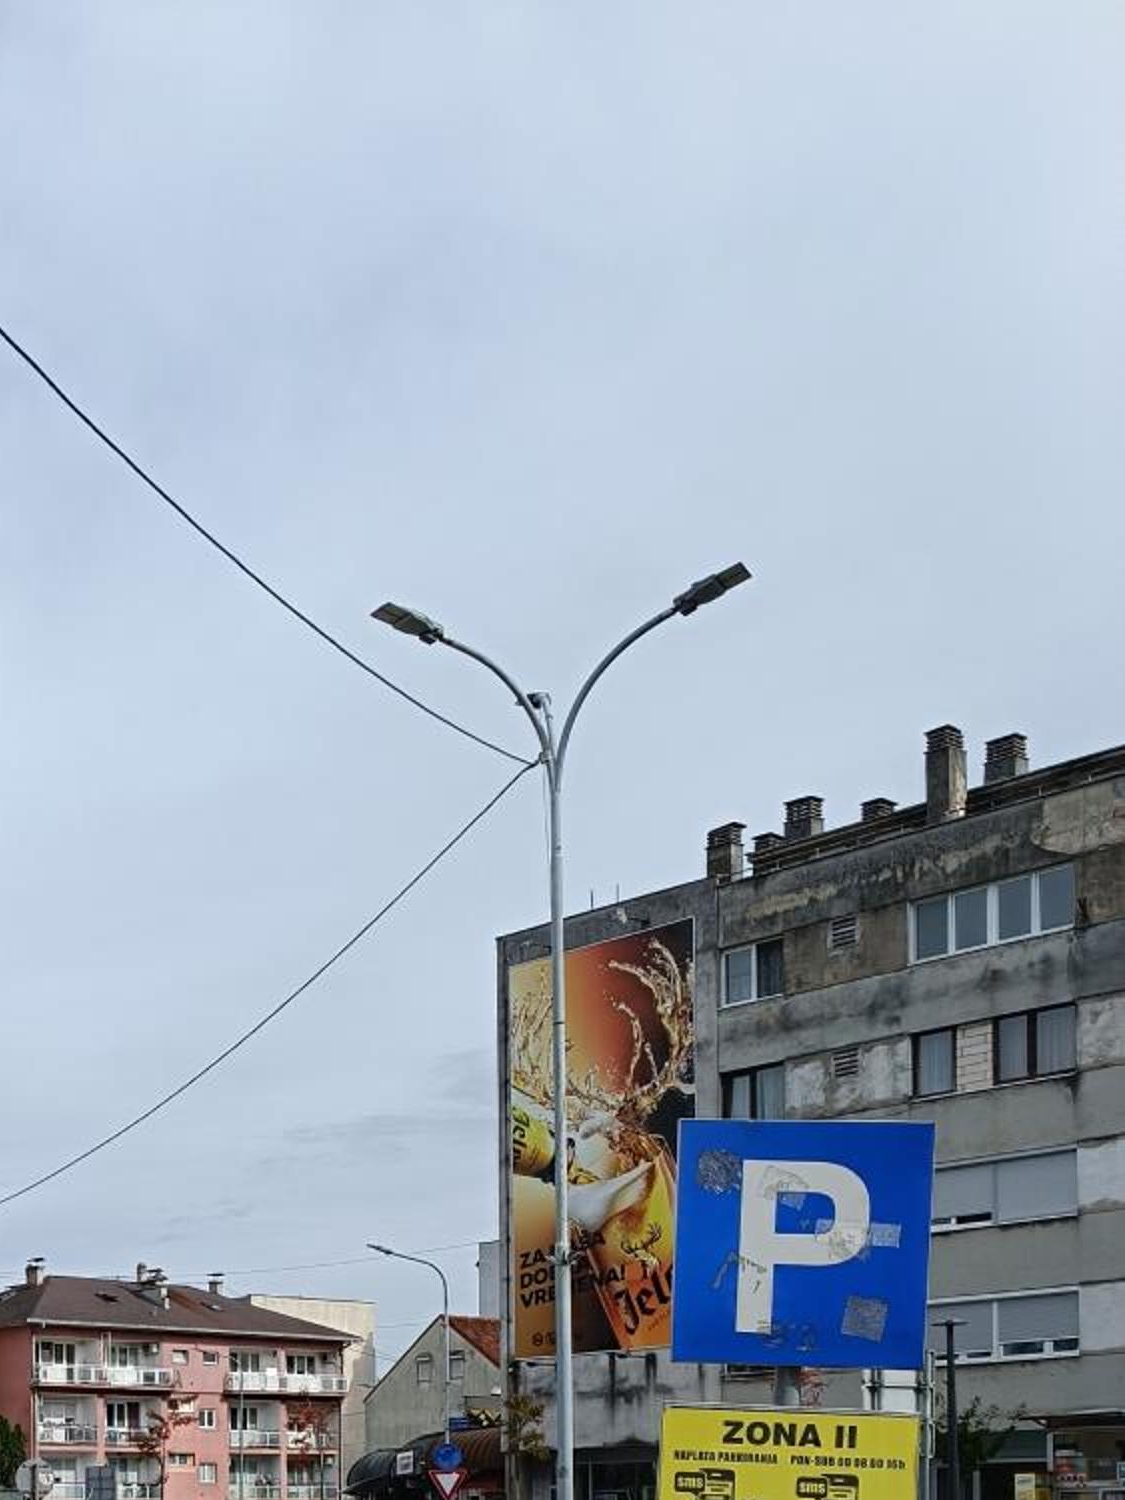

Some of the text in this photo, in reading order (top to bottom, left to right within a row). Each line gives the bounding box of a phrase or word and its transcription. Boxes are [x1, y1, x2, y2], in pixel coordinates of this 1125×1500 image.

[520, 1248, 546, 1269] ZA
[735, 1159, 870, 1335] P
[520, 1264, 626, 1308] VREENA!
[722, 1420, 857, 1448] ZONA II
[674, 1450, 778, 1465] NAPLATA PARKIRANJA
